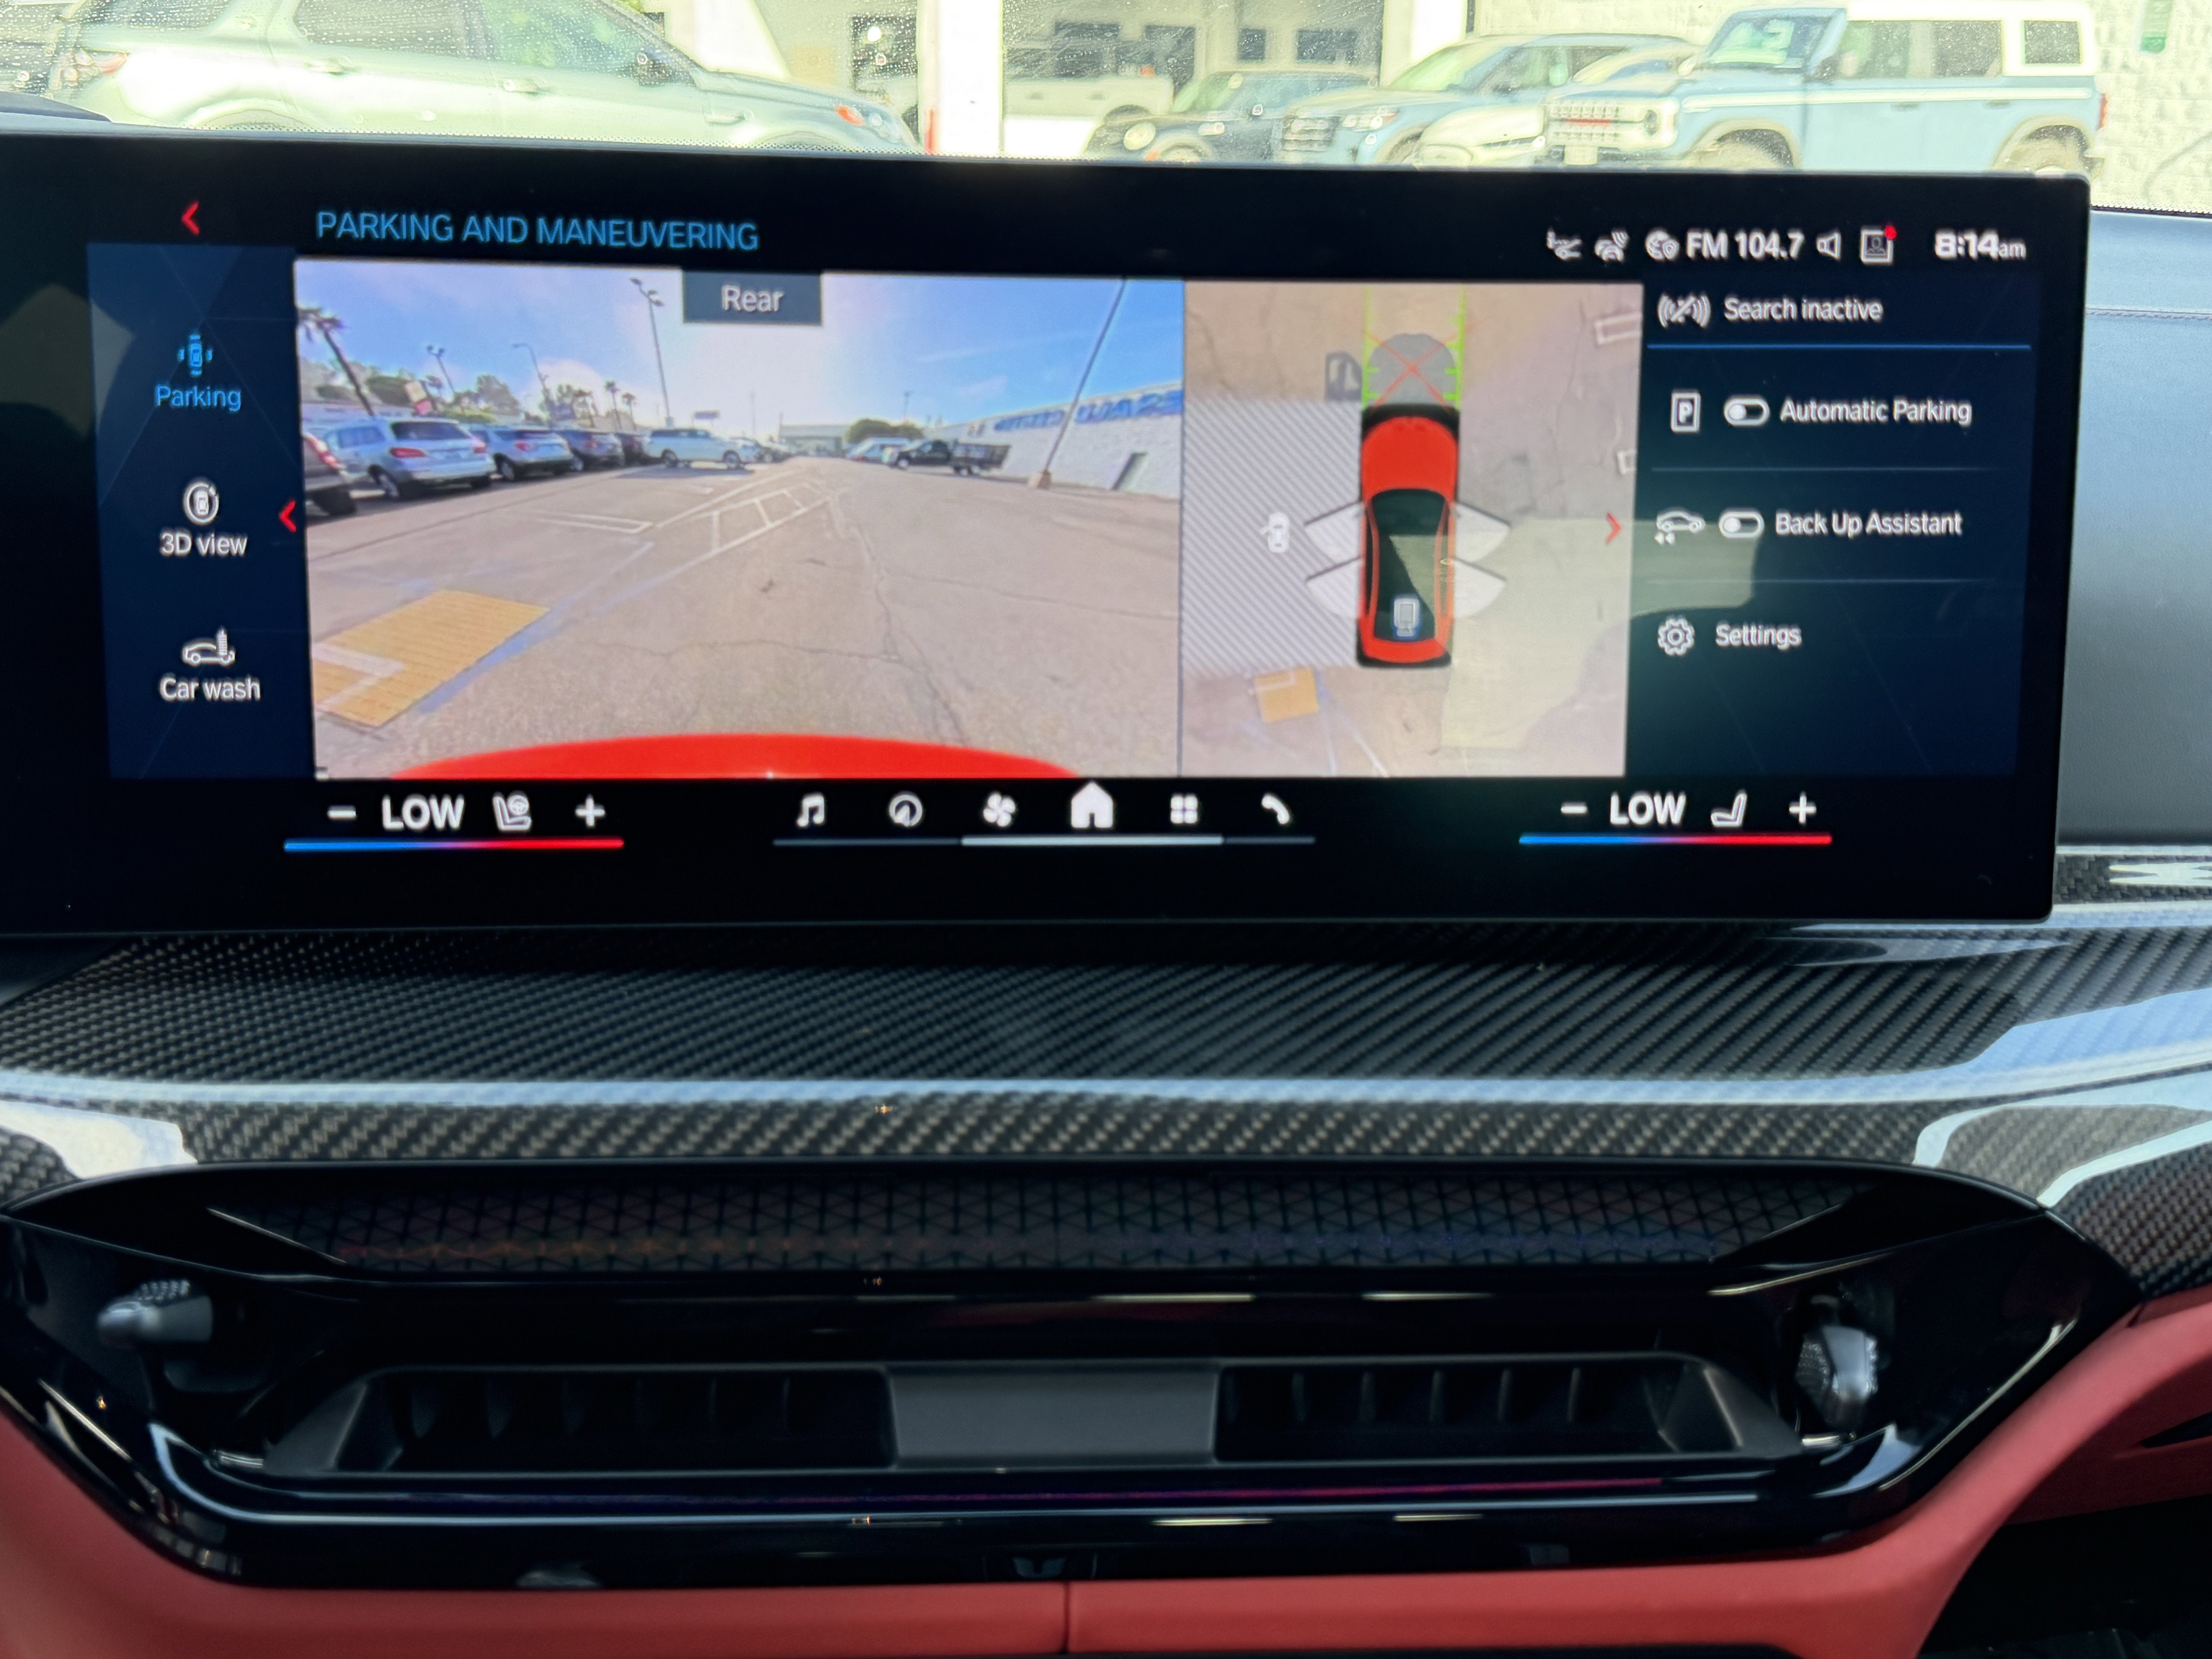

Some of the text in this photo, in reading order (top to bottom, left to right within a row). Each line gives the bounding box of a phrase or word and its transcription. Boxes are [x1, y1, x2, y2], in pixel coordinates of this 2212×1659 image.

[318, 212, 758, 250] PARKING AND MANEUVERING
[1686, 231, 1805, 259] FM 104.7
[1934, 232, 2027, 259] 8:14am
[722, 285, 783, 311] Rear
[1724, 297, 1883, 321] Search inactive
[155, 385, 241, 411] Parking
[1780, 399, 1972, 426] Automatic Parking
[1776, 512, 1962, 538] Back Up Assistant
[160, 531, 247, 555] 3D view
[1716, 623, 1802, 649] Settings
[160, 677, 261, 700] Car wash
[382, 796, 464, 830] LOW
[1610, 792, 1686, 825] LOW
